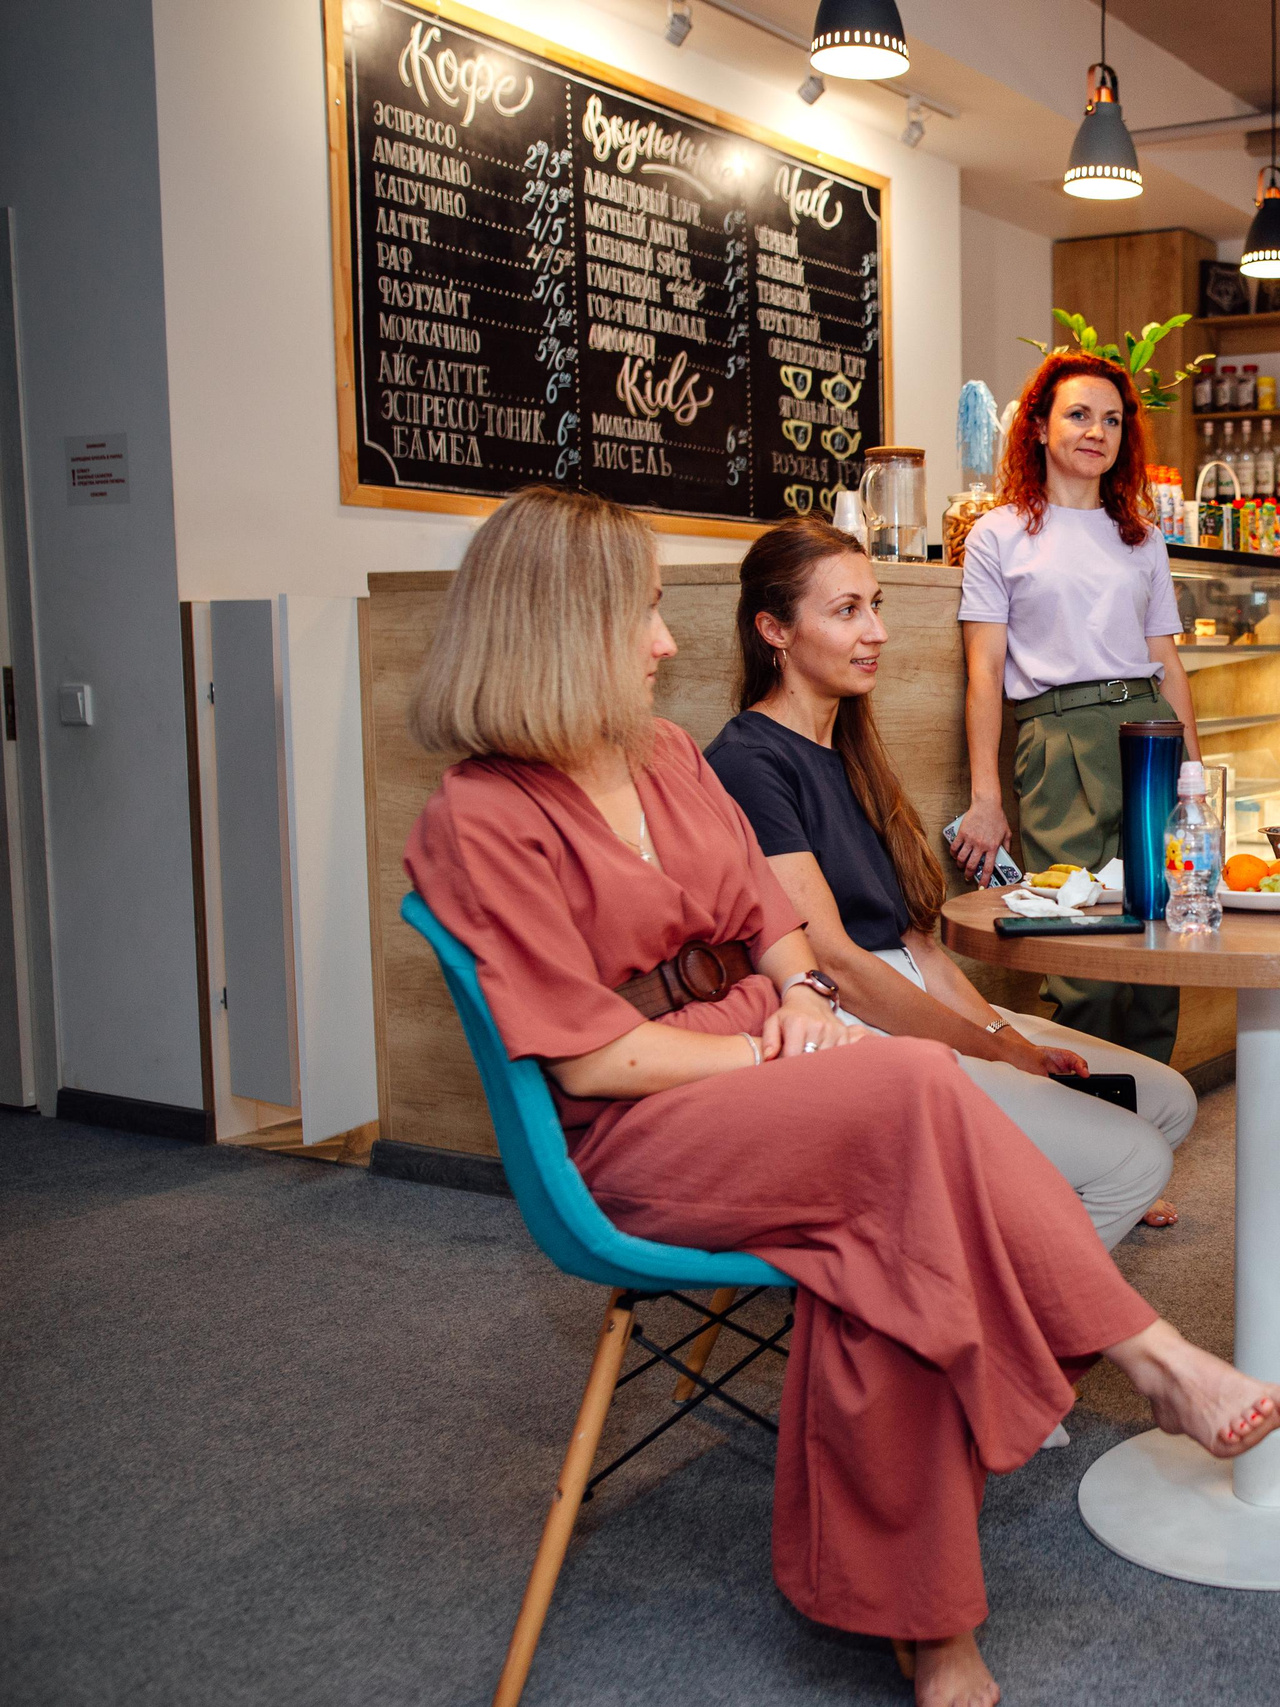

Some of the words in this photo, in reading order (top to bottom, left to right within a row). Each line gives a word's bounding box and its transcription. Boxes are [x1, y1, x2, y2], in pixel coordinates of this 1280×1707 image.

[398, 21, 534, 127] Кофе
[373, 100, 457, 150] ЭСПРЕССО
[372, 136, 471, 187] АМЕРИКАНО
[374, 171, 467, 218] КАПУЧИНО
[774, 164, 842, 230] Чай
[376, 207, 431, 245] ЛАТТЕ
[584, 199, 648, 240] МЯТНЫЙ
[377, 241, 413, 273] РАФ
[531, 274, 566, 306] 5/6
[586, 262, 661, 303] ГЛИНТВЕЙН
[378, 276, 471, 319] ФЛЭТУАЙТ
[587, 292, 649, 330] ГОРЯЧИЙ
[649, 307, 707, 346] ШОКОЛАД
[379, 312, 480, 354] МОККАЧИНО
[588, 323, 656, 366] ЛИМОНАД
[378, 343, 491, 397] АЙС-ЛАТТЕ
[616, 350, 715, 426] Kids
[381, 390, 546, 444] ЭСПРЕССО-ТОНИК
[391, 424, 483, 467] БАМБЛ
[592, 440, 672, 476] КИСЕЛЬ
[772, 451, 829, 483] РОЗОВАЯ
